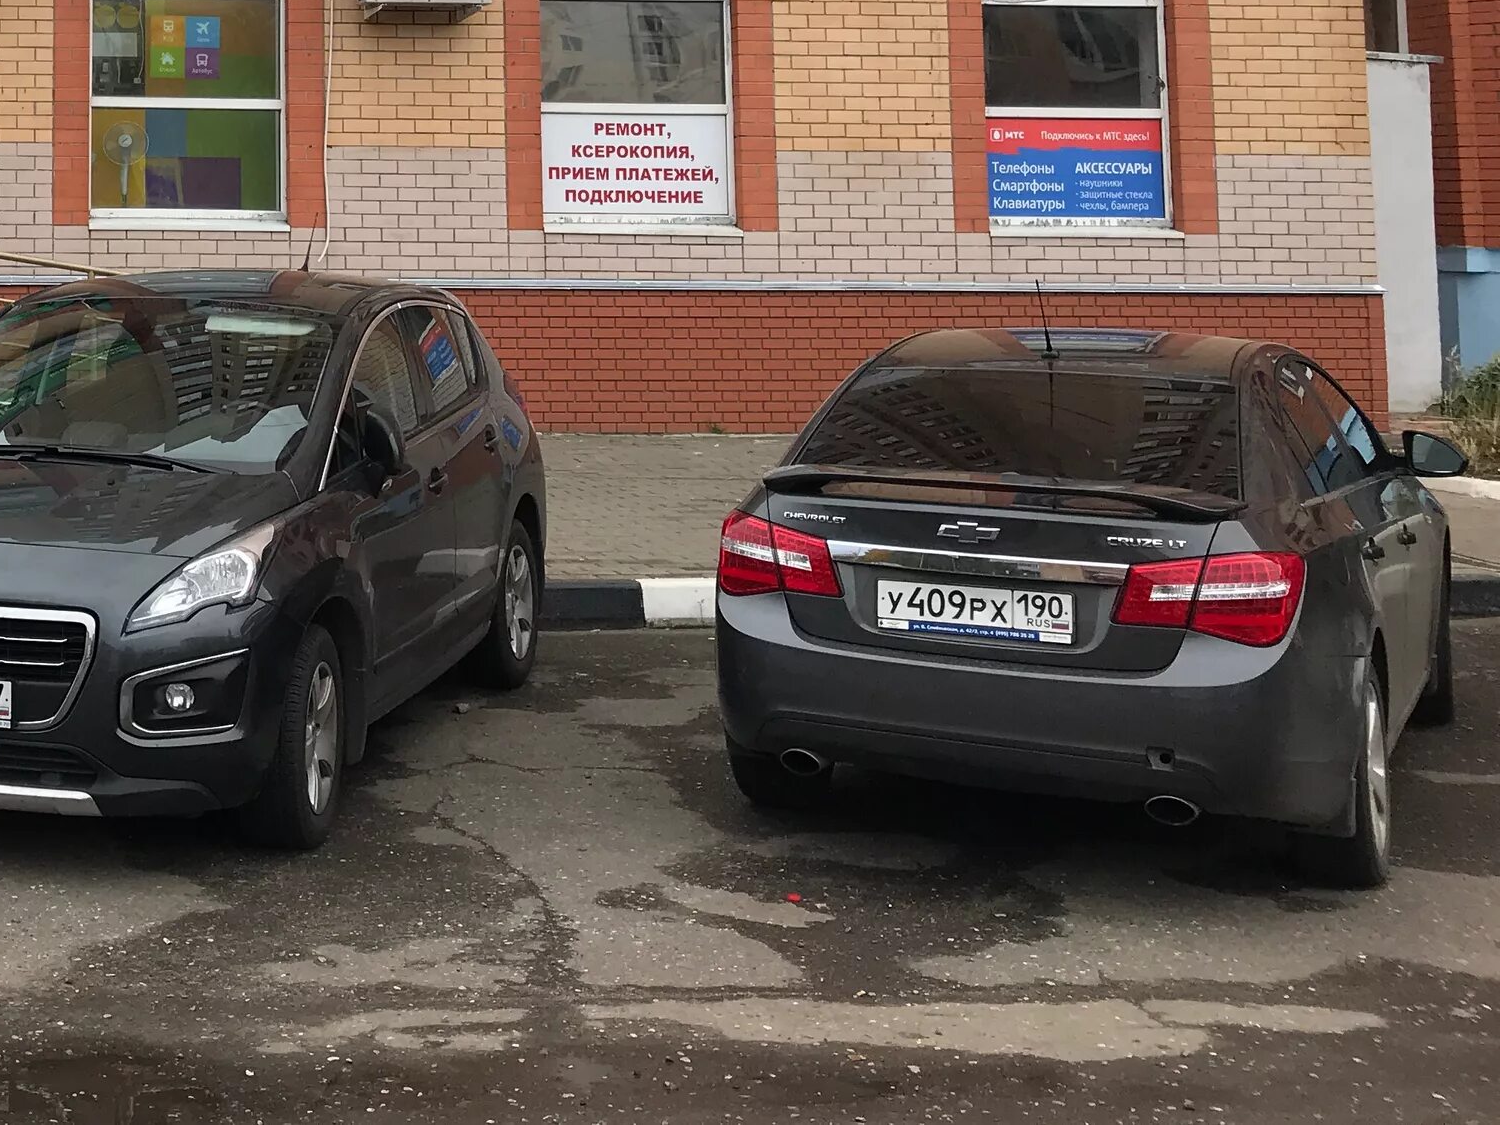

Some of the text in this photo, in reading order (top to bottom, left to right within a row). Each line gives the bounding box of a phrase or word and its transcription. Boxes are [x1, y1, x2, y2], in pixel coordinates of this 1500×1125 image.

[594, 122, 671, 138] РЕМОНТ,
[1041, 131, 1095, 141] Подключись
[1103, 132, 1122, 140] МТС
[1123, 132, 1150, 141] здесь!
[571, 145, 695, 161] КСЕРОКОПИЯ,
[548, 166, 720, 184] ПРИЕМ ПЛАТЕЖЕЙ,
[991, 161, 1055, 176] Телефоны
[1075, 162, 1152, 174] АКСЕССУАРЫ
[993, 179, 1064, 194] Смартфоны
[565, 189, 704, 205] ПОДКЛЮЧЕНИЕ
[1079, 191, 1153, 200] защитные стекла
[993, 197, 1065, 214] Клавиатуры
[1080, 201, 1149, 212] чехлы, бампера
[784, 511, 847, 523] CHEVROLET
[1107, 536, 1187, 548] CRUZE LT
[1016, 593, 1063, 619] 190
[1027, 618, 1051, 627] RUS
